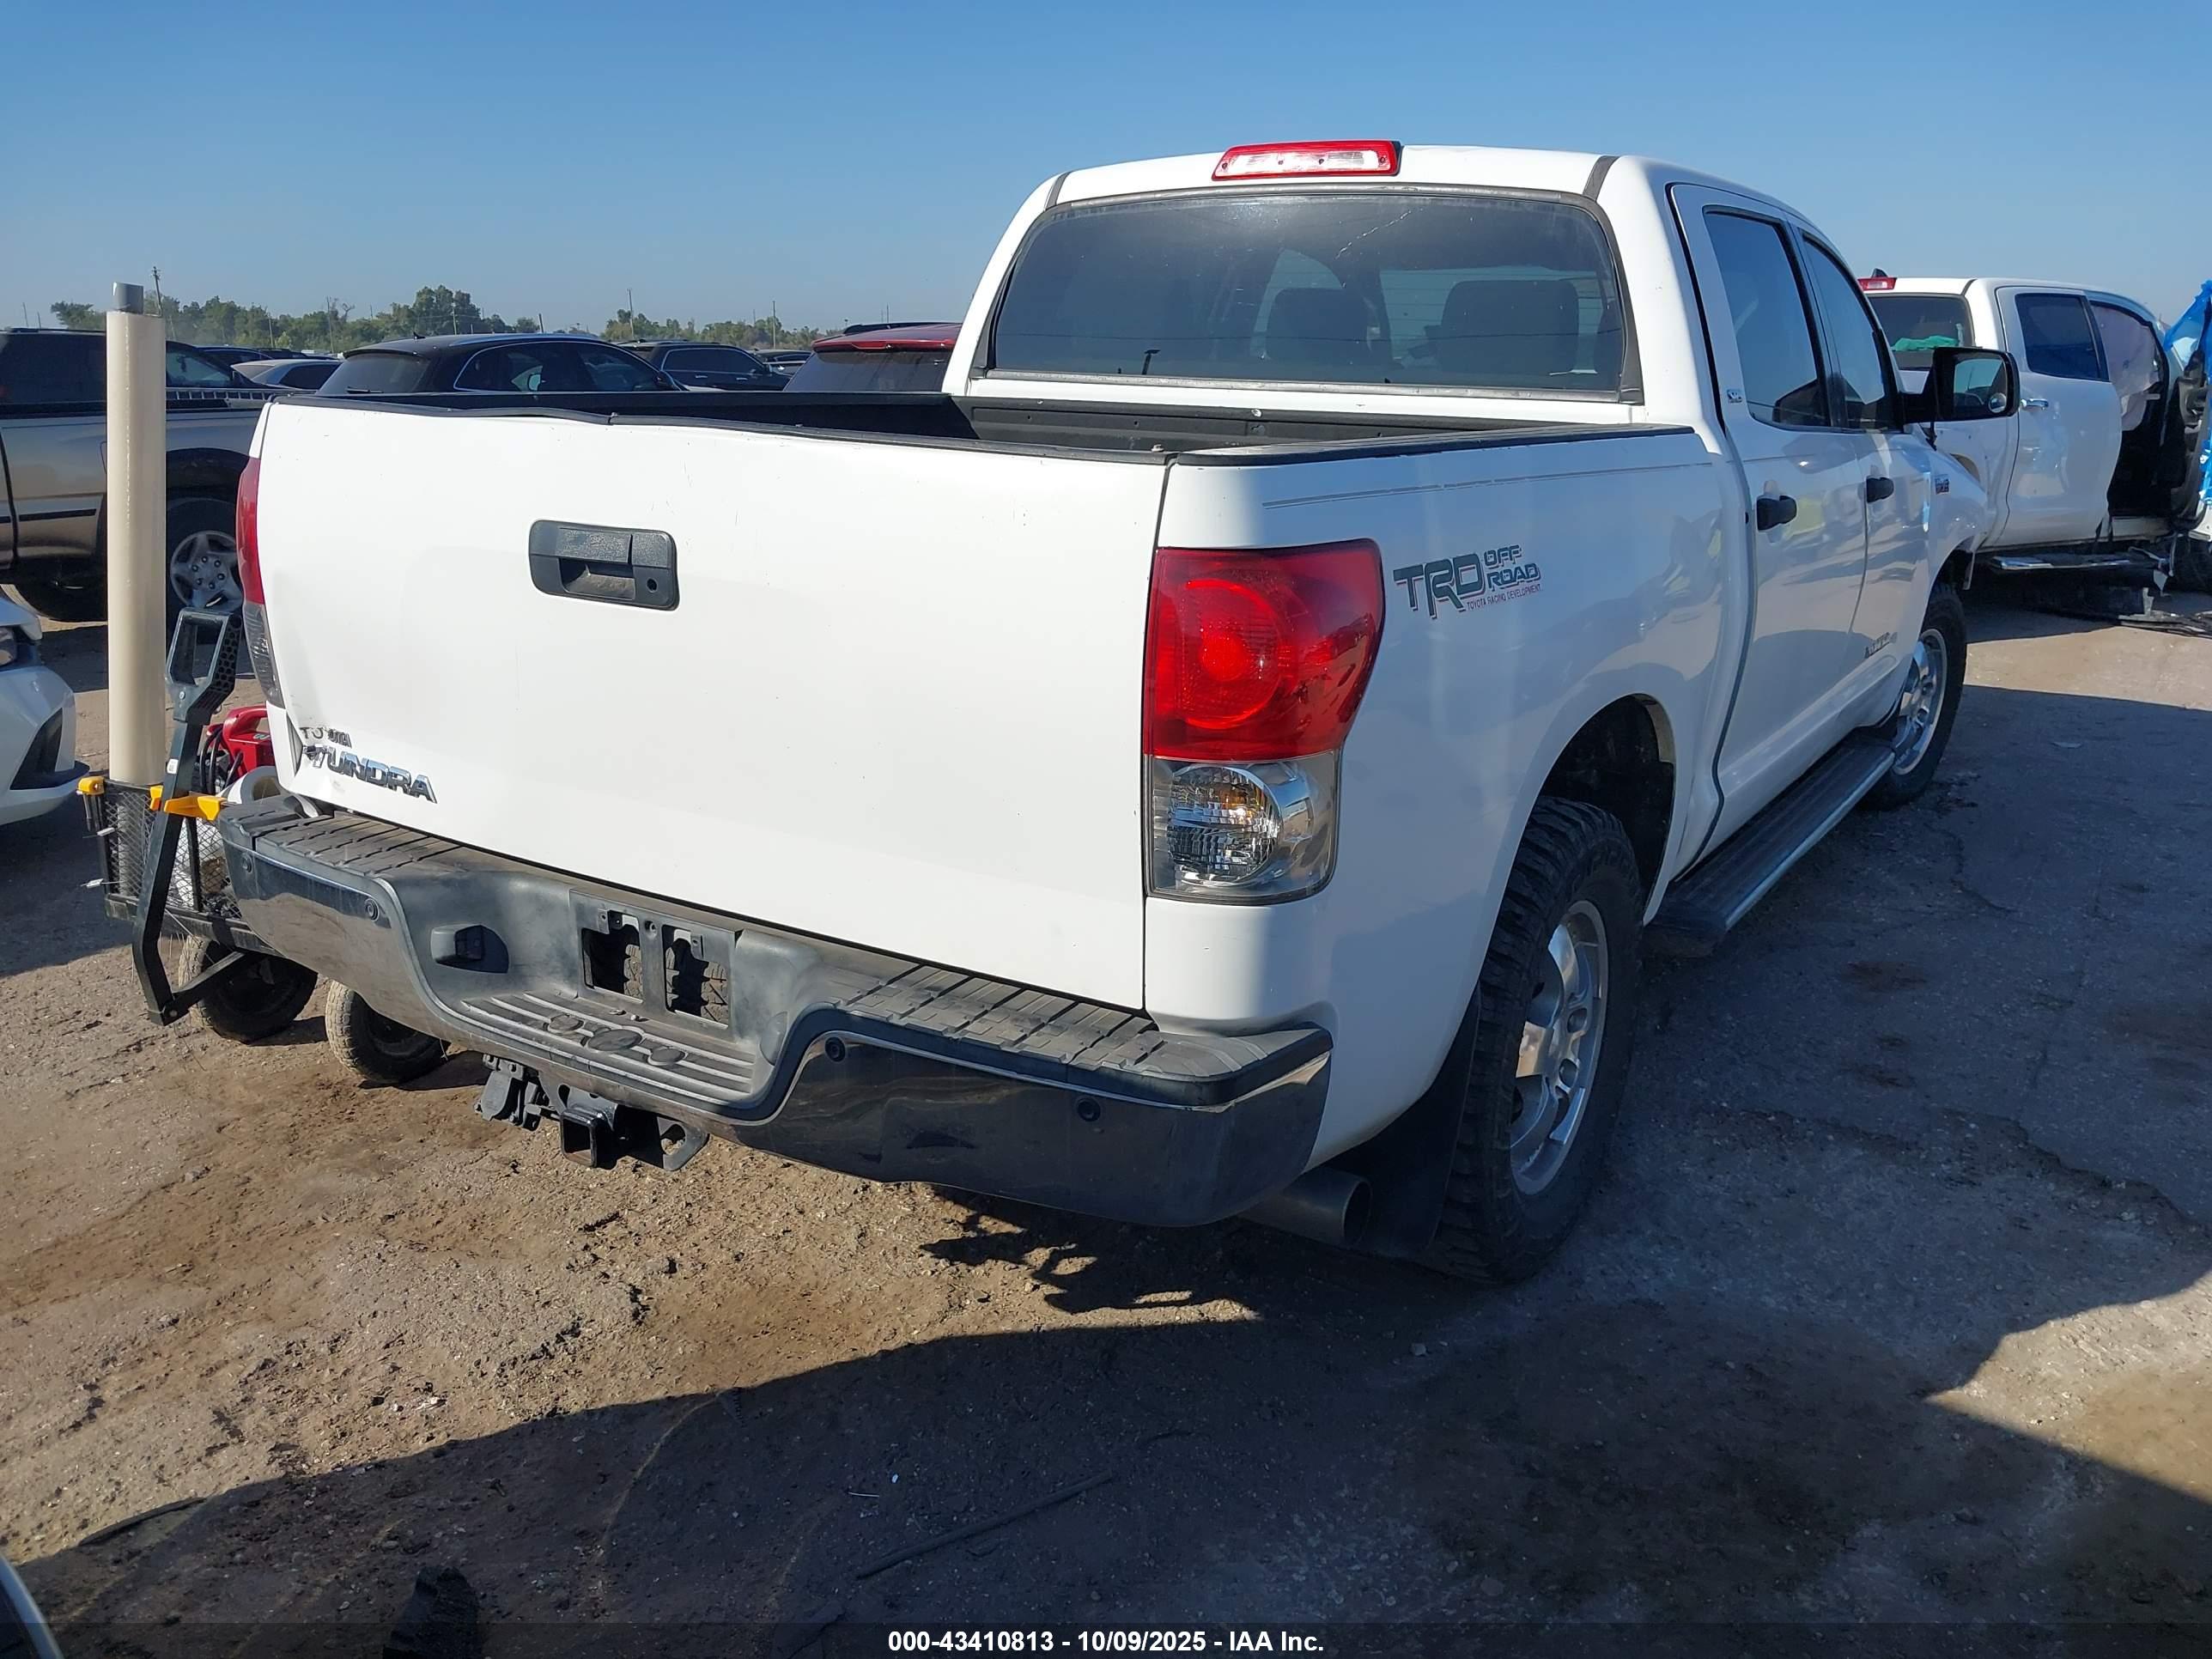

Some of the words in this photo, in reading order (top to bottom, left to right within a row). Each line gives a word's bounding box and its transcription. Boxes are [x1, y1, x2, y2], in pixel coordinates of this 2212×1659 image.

[1483, 544, 1522, 570] OFF
[1393, 553, 1486, 620] TRD
[1486, 562, 1541, 592] ROAD
[1467, 598, 1486, 611] TOYOTA
[1506, 583, 1540, 600] DEVELOPMENT
[302, 744, 437, 804] TUNDRA
